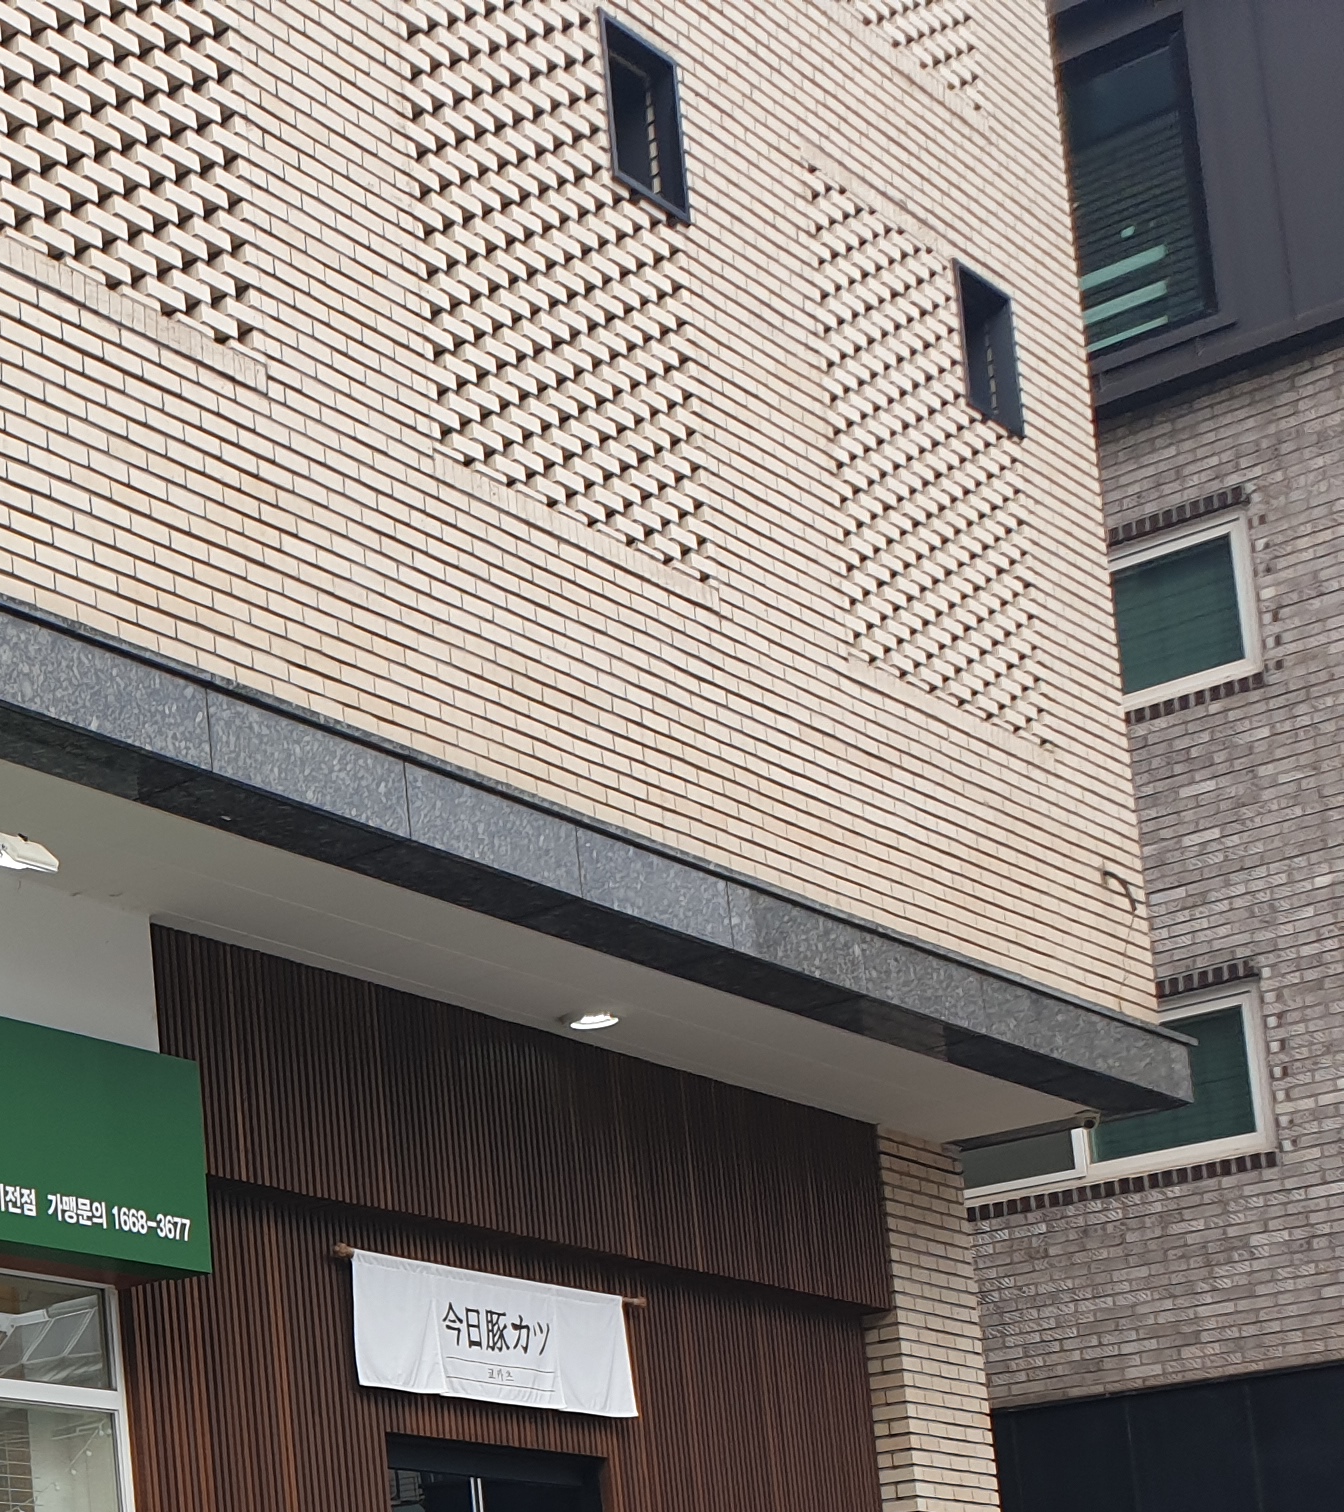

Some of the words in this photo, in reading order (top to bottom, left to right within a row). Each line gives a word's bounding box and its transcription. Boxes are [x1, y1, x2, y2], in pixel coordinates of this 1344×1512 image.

[47, 1193, 107, 1229] 가맹문의
[112, 1206, 191, 1241] 1668-3677
[442, 1301, 550, 1356] 今日豚カツ
